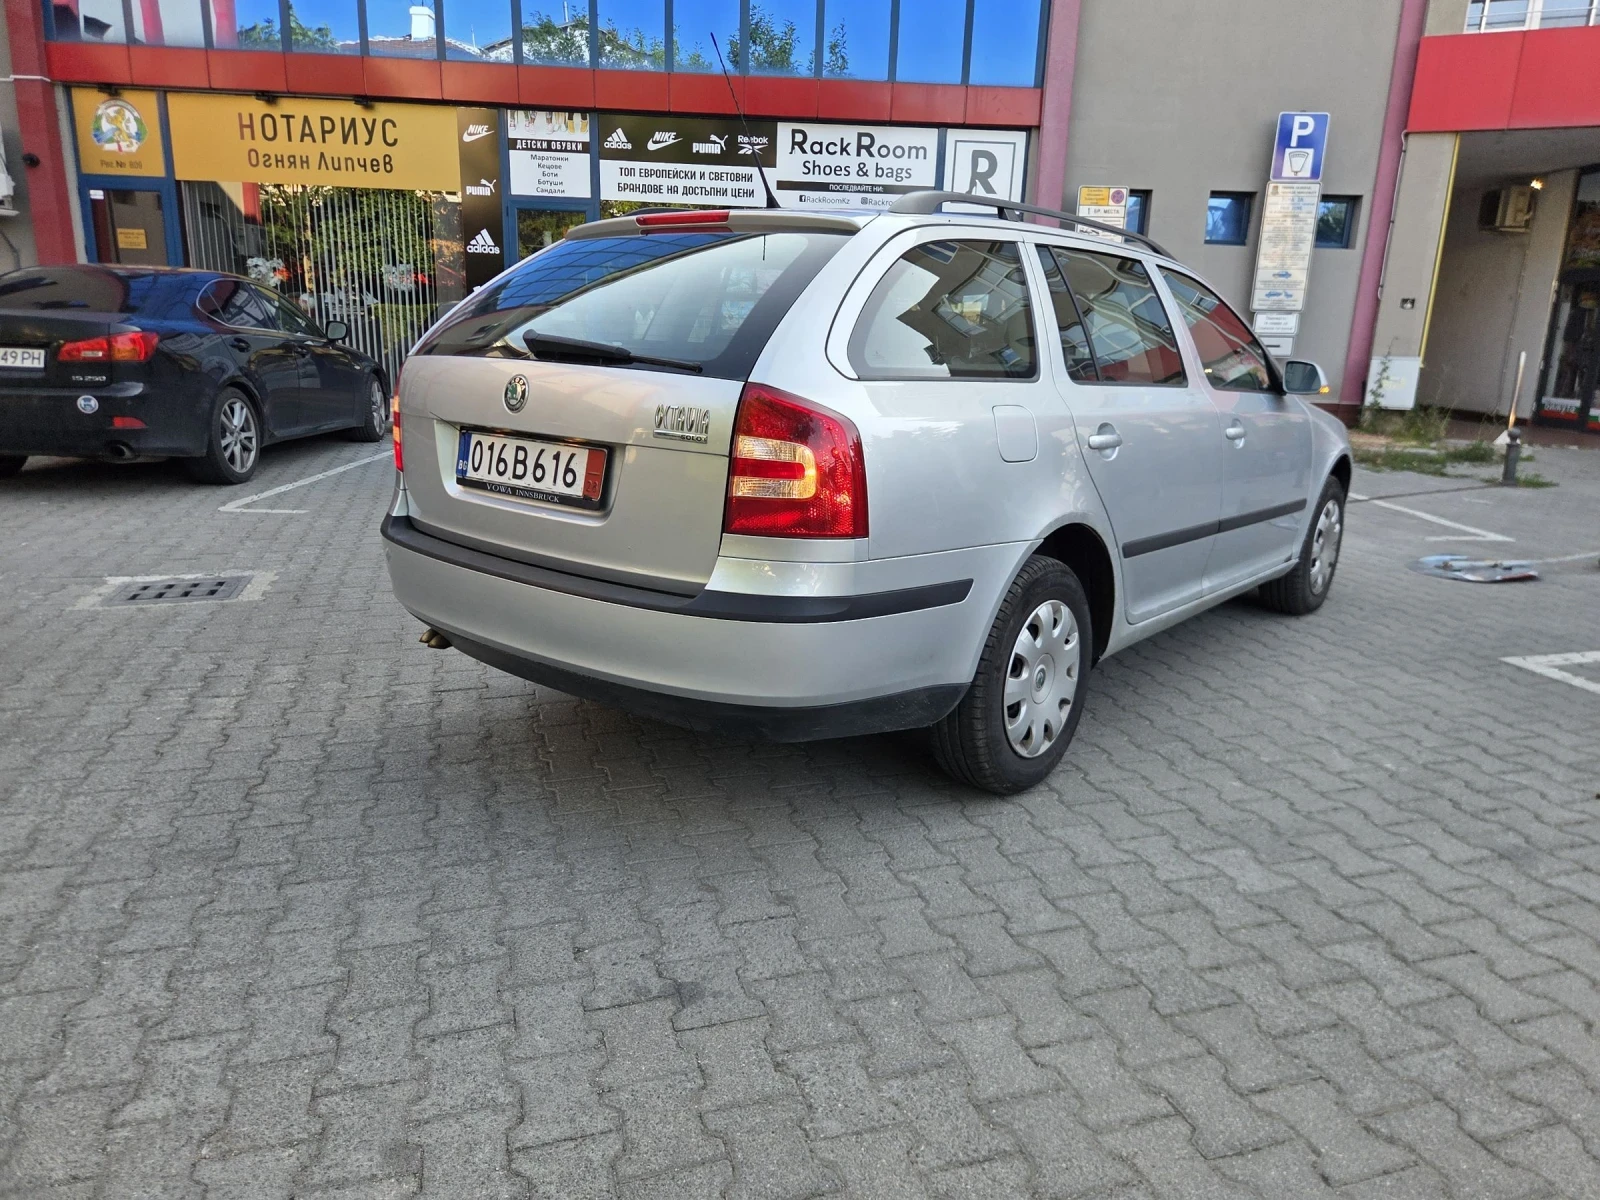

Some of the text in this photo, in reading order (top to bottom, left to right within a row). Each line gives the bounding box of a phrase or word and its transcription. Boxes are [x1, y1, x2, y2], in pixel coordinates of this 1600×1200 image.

[237, 111, 399, 148] НОТАРИУС
[467, 124, 489, 134] NIKE
[1290, 116, 1315, 147] P
[653, 131, 677, 142] NIKE
[516, 139, 583, 151] ДЕТСКИ ОБУВКИ
[603, 141, 632, 150] adidas
[692, 142, 721, 155] PUMA
[789, 128, 928, 160] Rack Room
[247, 148, 394, 174] Огнян Липчев
[530, 154, 569, 163] Маратонки
[537, 163, 563, 171] Кецове
[802, 160, 912, 182] Shoes & bags
[542, 170, 559, 178] Боти
[619, 167, 753, 183] ТОП ЕВРОПЕЙСКИ И СВЕТОВНИ
[537, 178, 564, 188] Ботуши
[829, 184, 872, 193] ПОСЛЕДВАЙТЕ
[466, 185, 491, 196] PUMA
[535, 187, 566, 195] Сандали
[617, 182, 755, 199] БРАНДОВЕ НА ДОСТЪПНИ ЦЕНИ
[806, 196, 851, 205] RackRoomKz
[467, 244, 500, 254] adidas
[655, 403, 710, 434] OCTAVIA
[458, 459, 468, 470] BG
[471, 440, 577, 488] 016B616
[486, 483, 560, 503] VOWA INNSBRUCK
